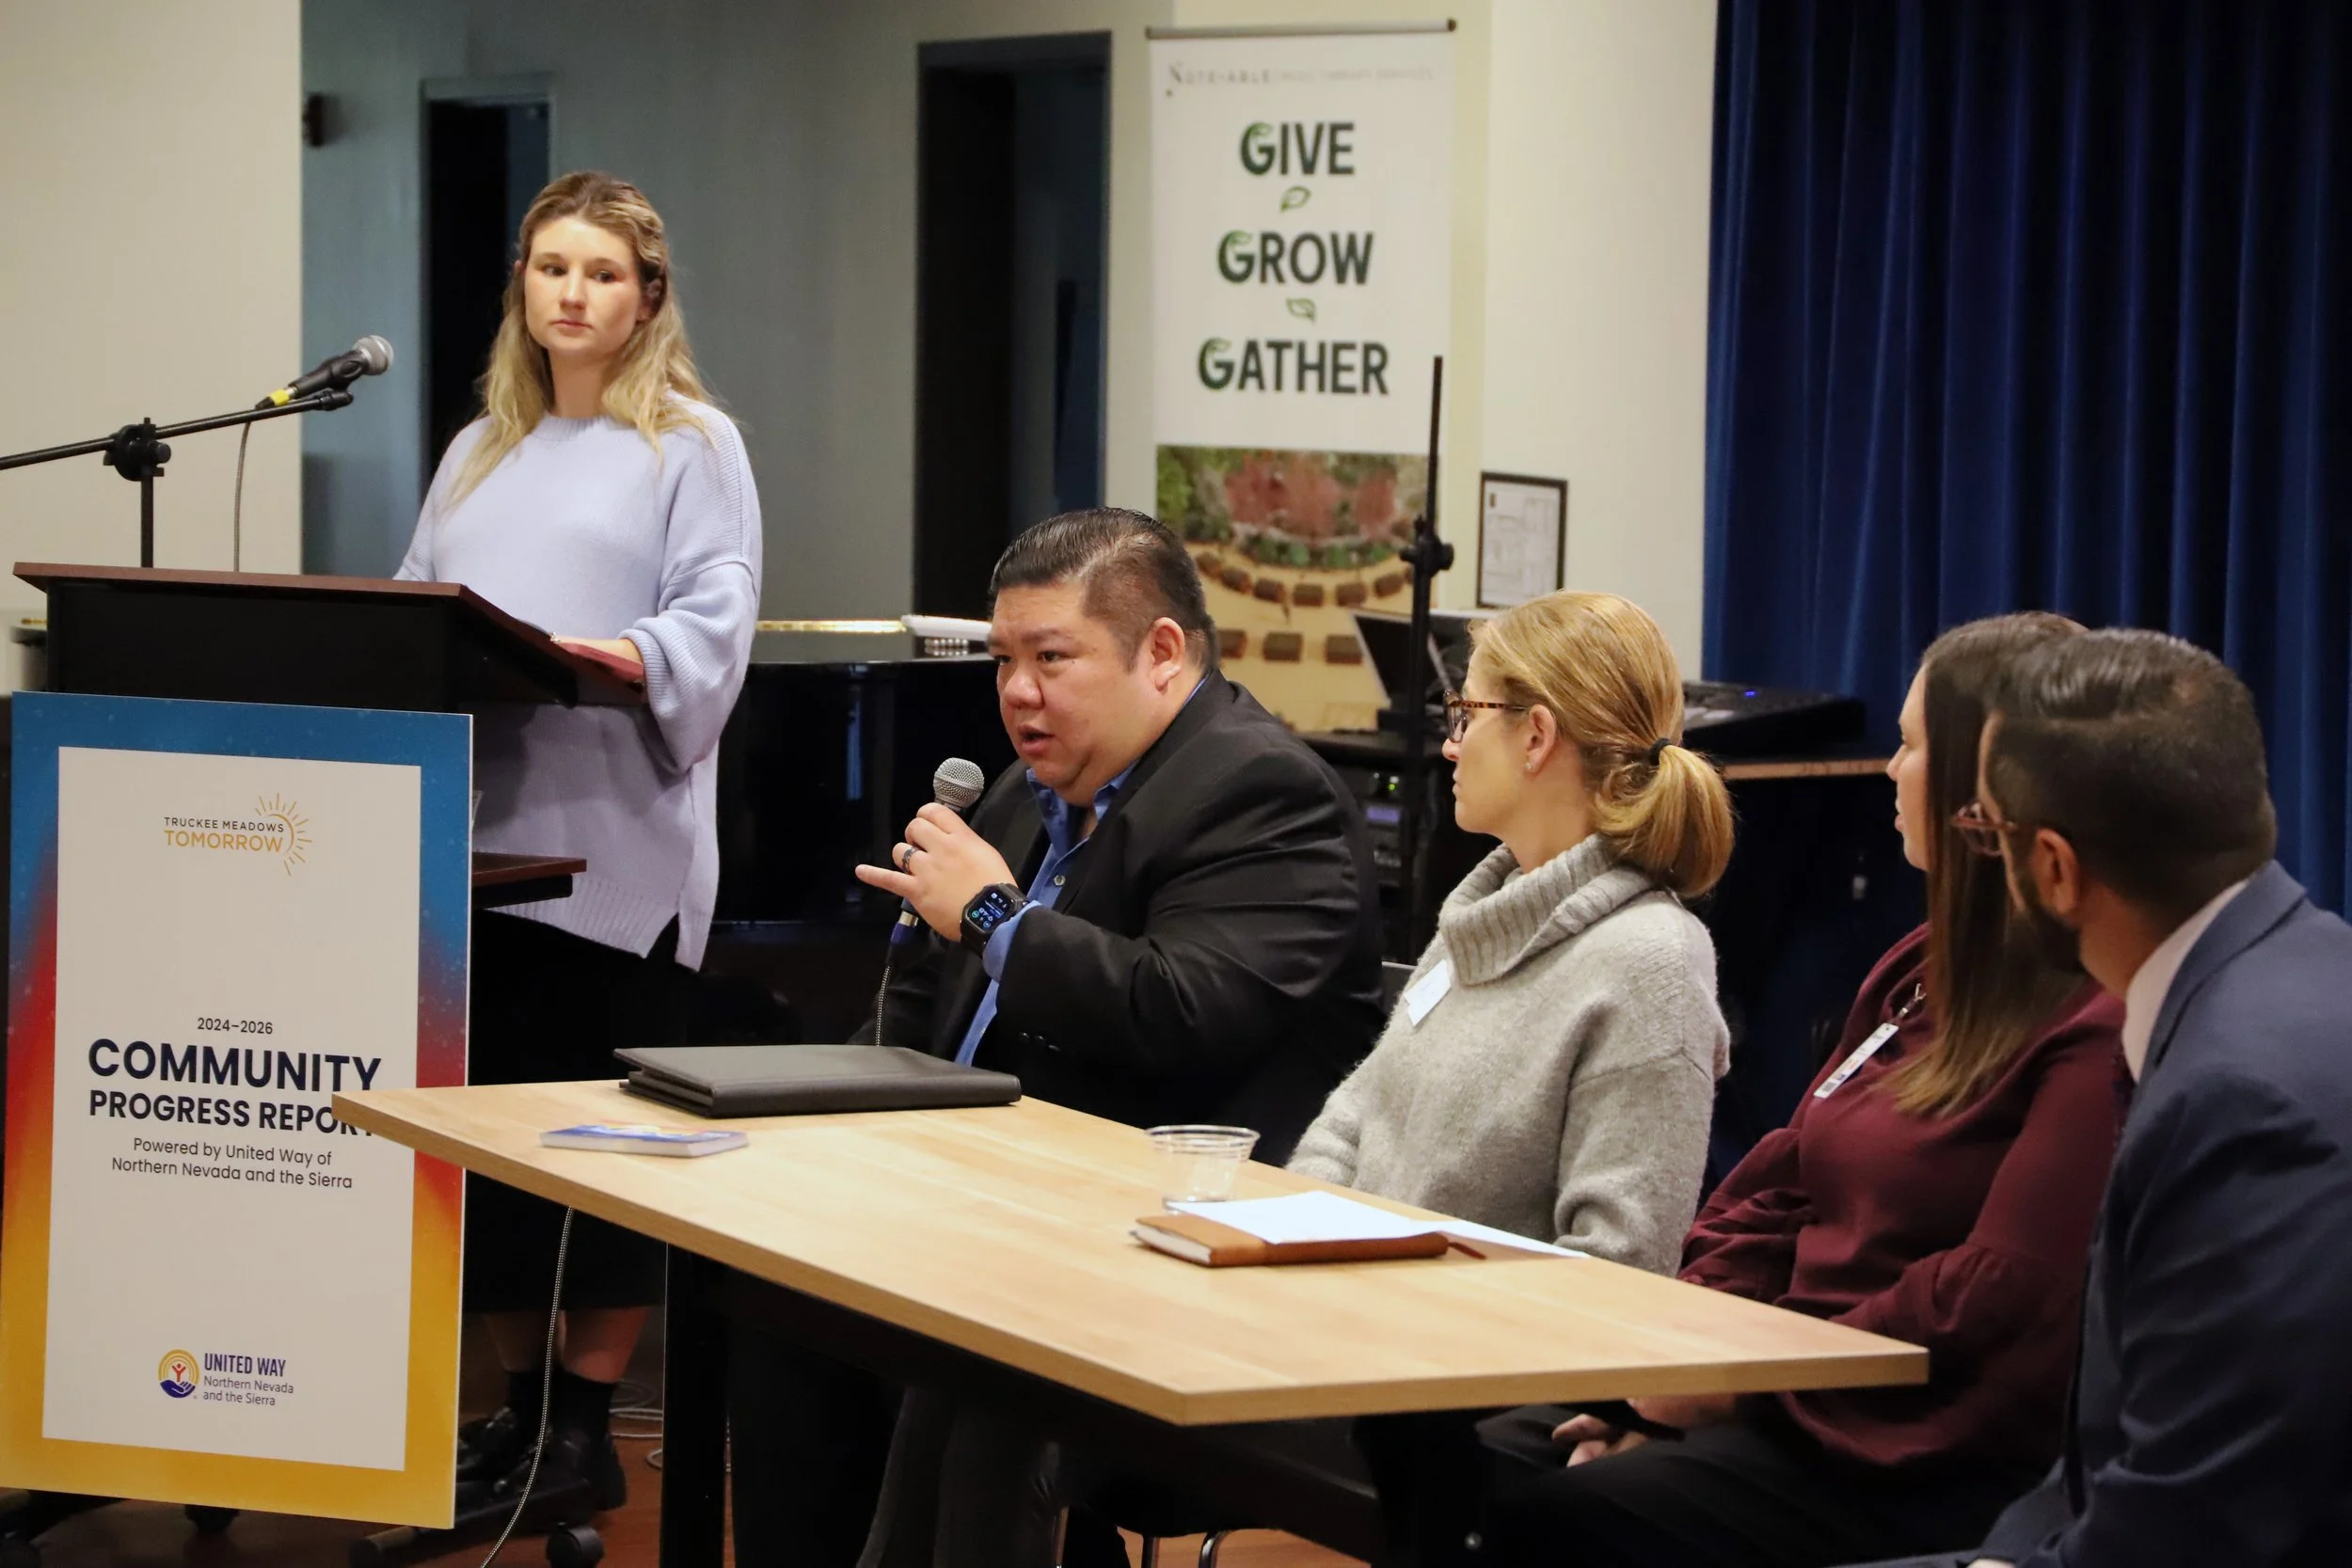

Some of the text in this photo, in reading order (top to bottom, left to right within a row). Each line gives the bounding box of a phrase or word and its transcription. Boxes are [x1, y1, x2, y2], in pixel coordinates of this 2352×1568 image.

[1240, 121, 1355, 176] GIVE
[1217, 230, 1375, 285] GROW
[1198, 337, 1390, 395] GATHER
[165, 817, 284, 832] TRUCKEE MEADOWS
[165, 831, 283, 852] TOMORROW
[88, 1038, 381, 1092] COMMUNITY
[90, 1090, 373, 1135] PROGRESS REPO
[134, 1137, 332, 1168] Powered by United Way of
[112, 1157, 353, 1188] Northern Nevada and the Sierra
[204, 1353, 286, 1377] UNITED WAY
[203, 1376, 294, 1394] Northern Nevada
[203, 1390, 276, 1406] and the Sierra
